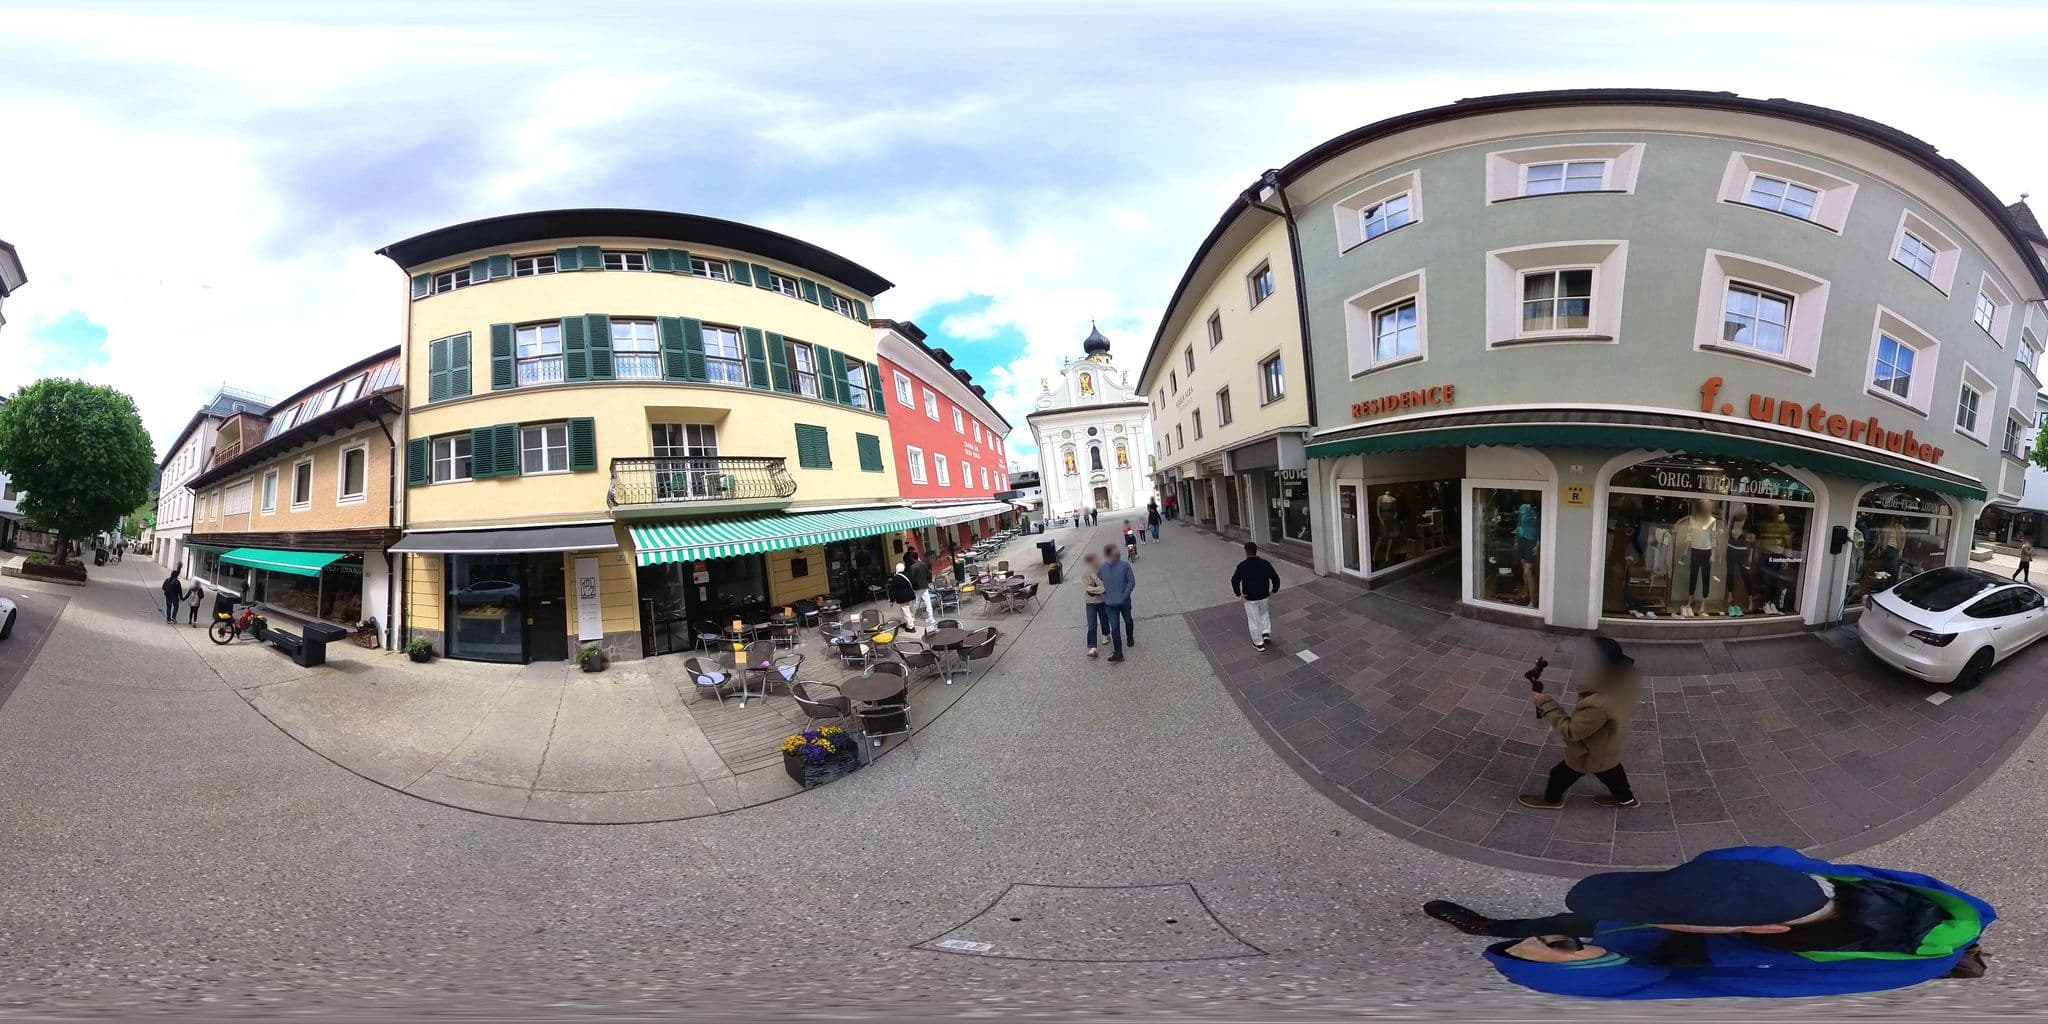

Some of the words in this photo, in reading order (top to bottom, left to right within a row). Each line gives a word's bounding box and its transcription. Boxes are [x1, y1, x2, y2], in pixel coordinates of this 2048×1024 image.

[1351, 384, 1455, 418] RESIDENCE
[1700, 376, 1734, 416] f.
[1750, 393, 1944, 465] unterhuber
[1658, 471, 1692, 488] ORIG.
[1697, 474, 1737, 492] TYROL
[1572, 493, 1579, 501] R
